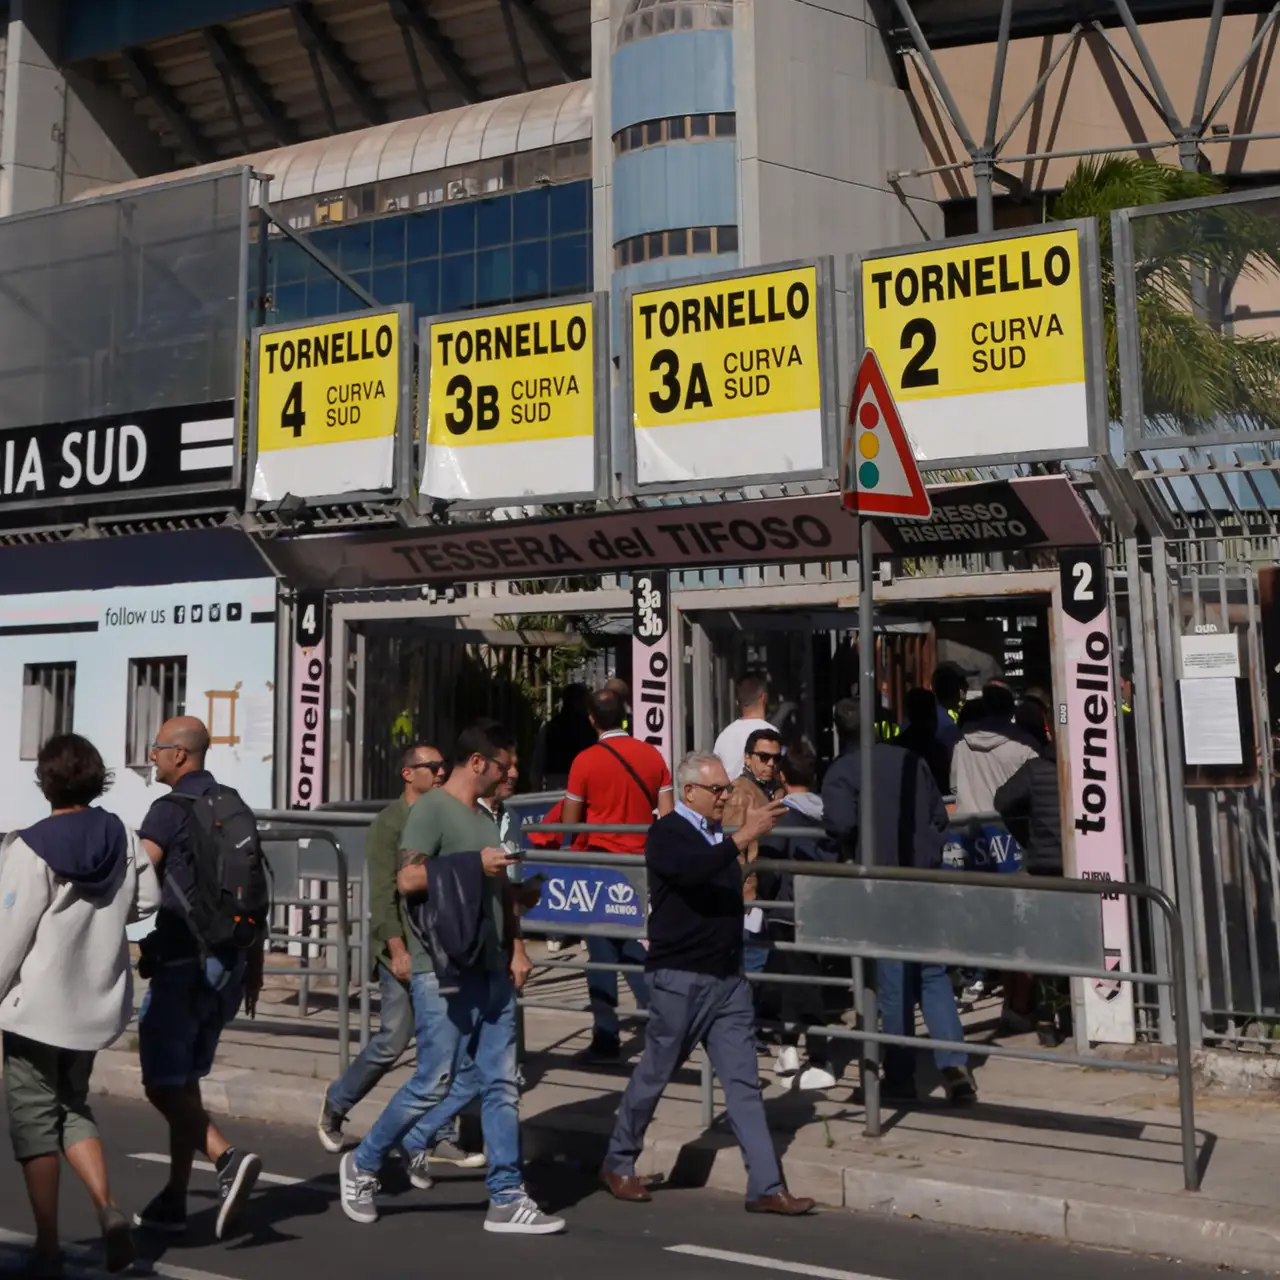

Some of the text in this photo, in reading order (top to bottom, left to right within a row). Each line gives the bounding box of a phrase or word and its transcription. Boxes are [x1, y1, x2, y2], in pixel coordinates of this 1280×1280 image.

[872, 245, 1071, 310] TORNELLO
[639, 281, 810, 340] TORNELLO
[265, 324, 393, 374] TORNELLO
[437, 315, 587, 366] TORNELLO
[900, 313, 1064, 389] 2 CURVA
[972, 345, 1026, 373] SUD
[648, 344, 803, 414] 3A CURVA
[724, 374, 771, 400] SUD
[280, 380, 386, 438] 4 CURVA
[326, 405, 361, 427] SUD
[444, 374, 580, 435] 3B CURVA
[511, 402, 551, 425] SUD
[58, 424, 148, 490] SUD
[392, 514, 833, 574] TESSERA del TIFOSO
[898, 520, 1027, 543] RISERVATO
[638, 577, 661, 609] 3a
[1072, 562, 1094, 601] 2
[105, 606, 148, 626] follow
[150, 609, 166, 624] us
[302, 604, 317, 635] 4
[638, 607, 663, 637] 3b
[1075, 631, 1110, 836] tornello
[974, 833, 1013, 865] SAV
[548, 878, 638, 916] SAV DAEWOO
